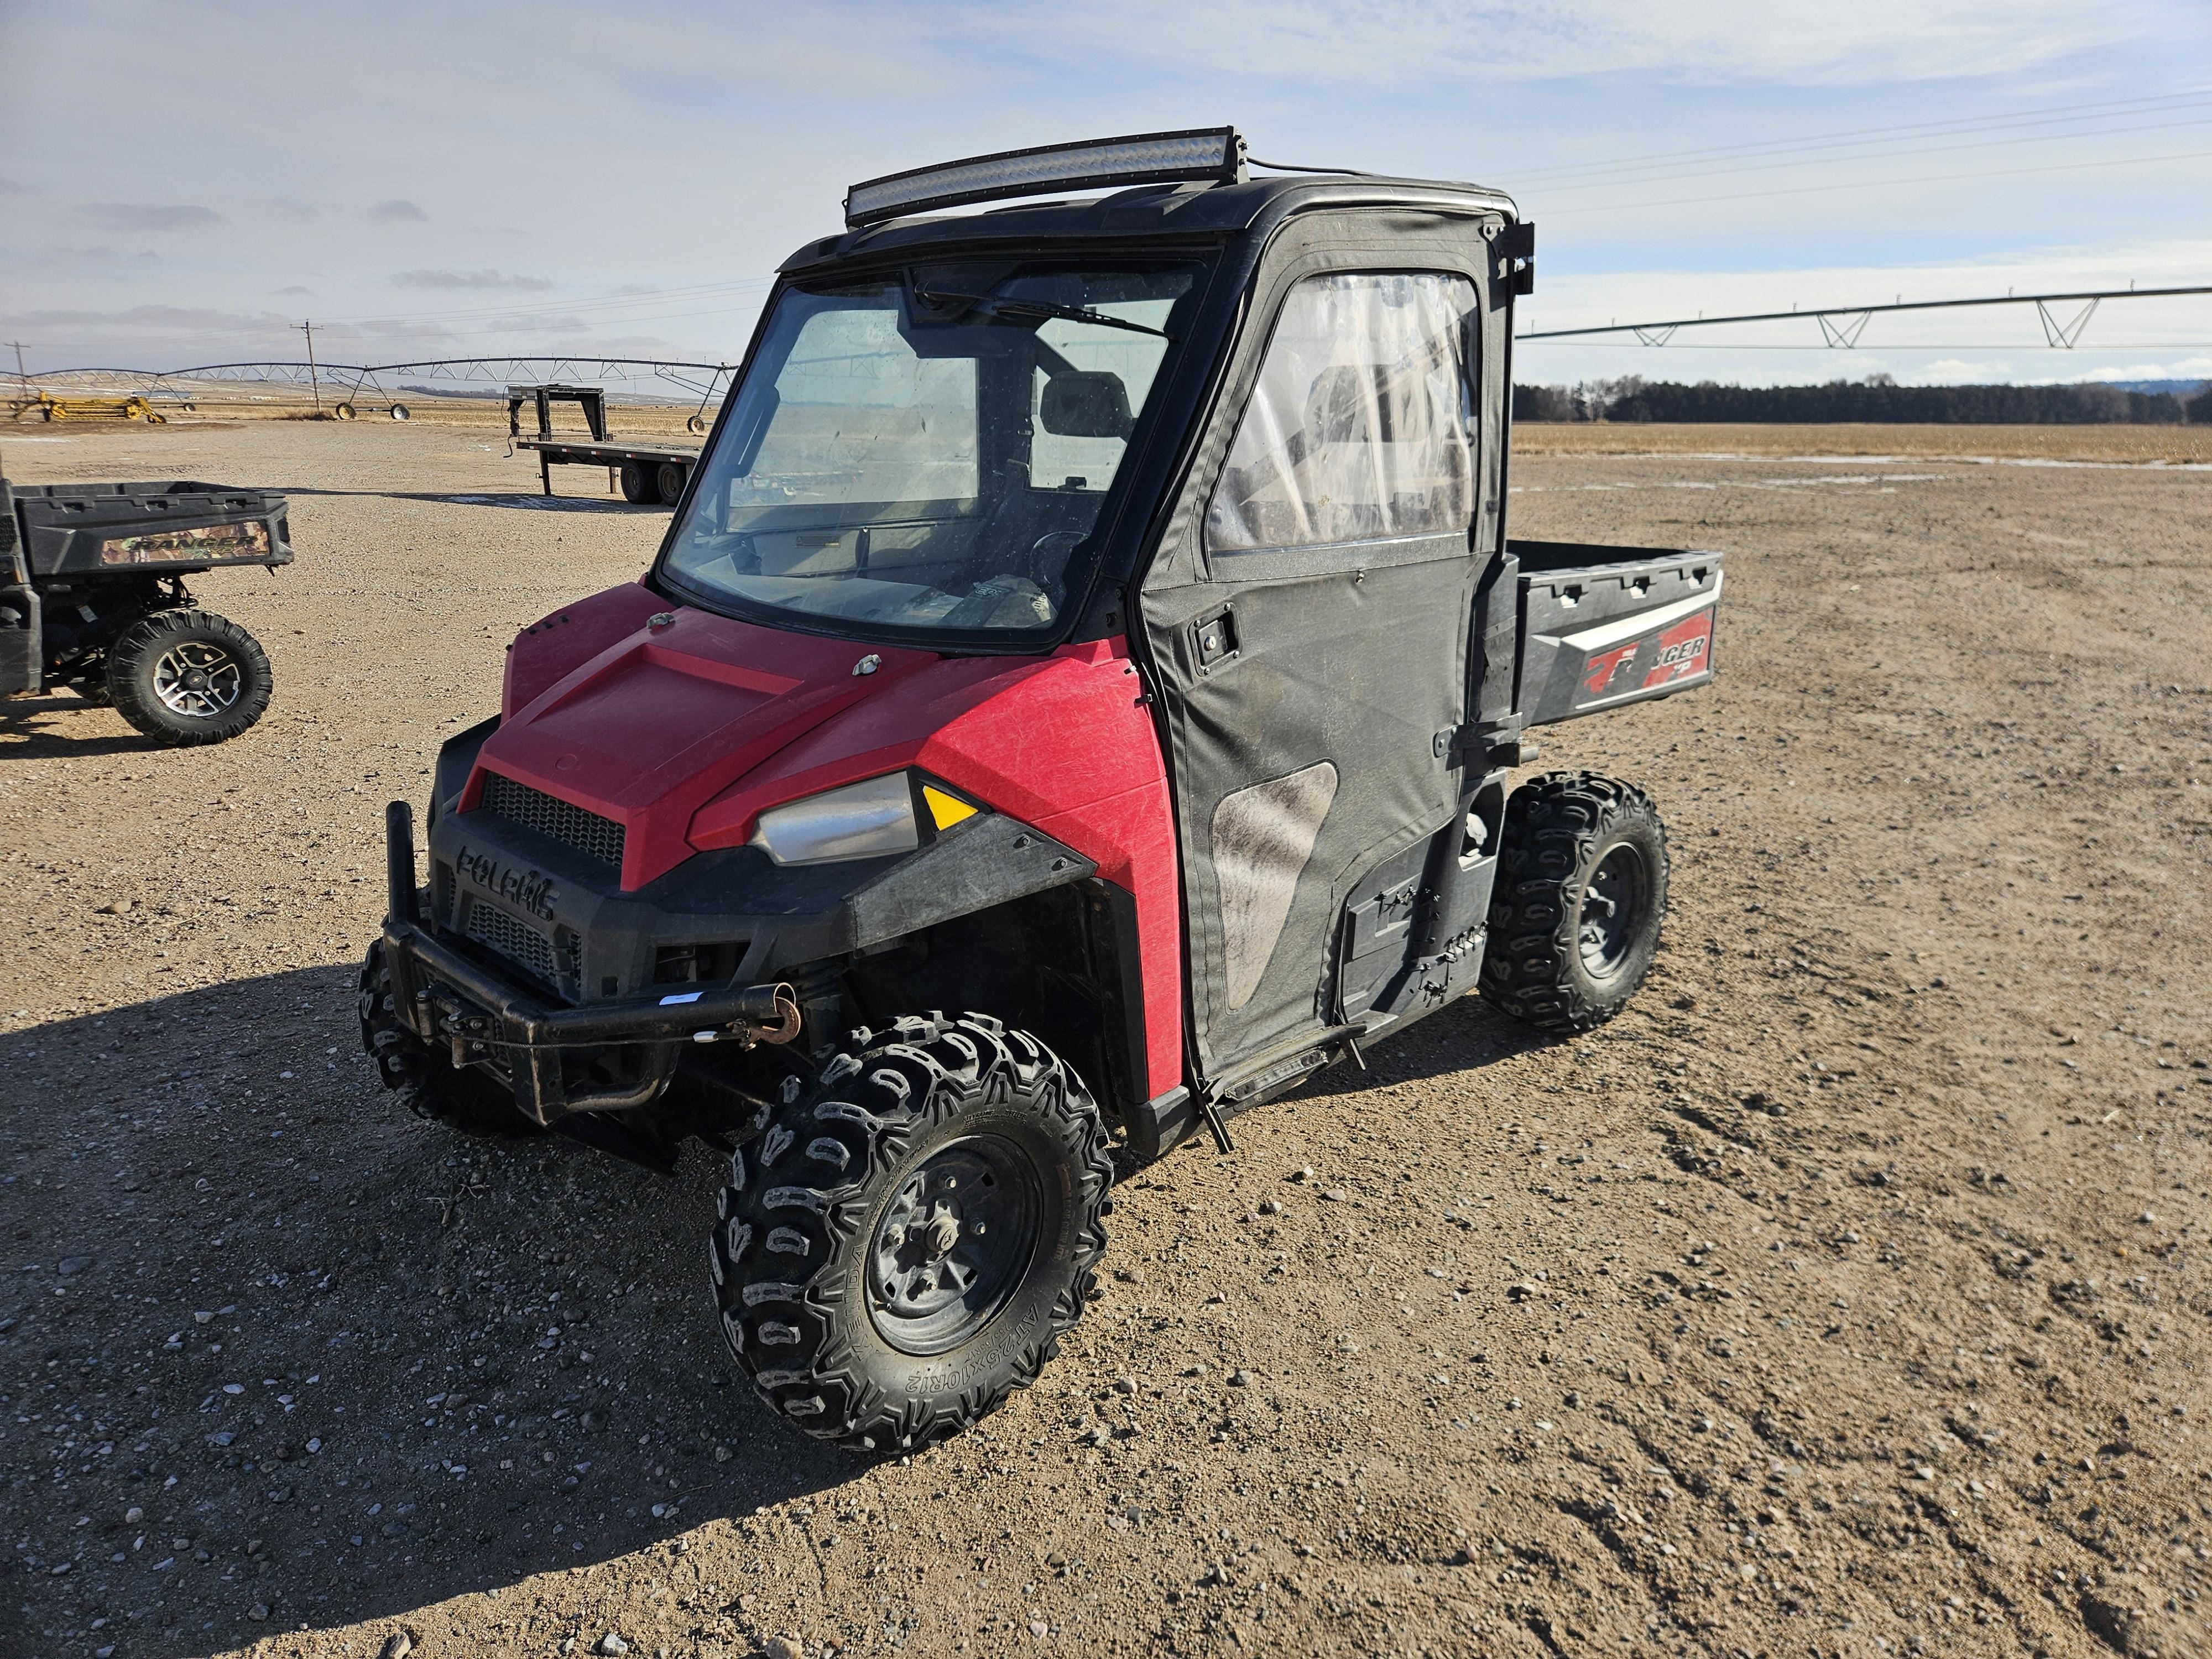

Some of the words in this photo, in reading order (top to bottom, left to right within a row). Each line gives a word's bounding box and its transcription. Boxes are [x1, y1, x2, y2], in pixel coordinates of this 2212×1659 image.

[129, 535, 258, 552] RANGER
[456, 845, 560, 922] POLARIS
[844, 1244, 874, 1361] KENDA
[966, 1323, 1012, 1362] 255/65R12
